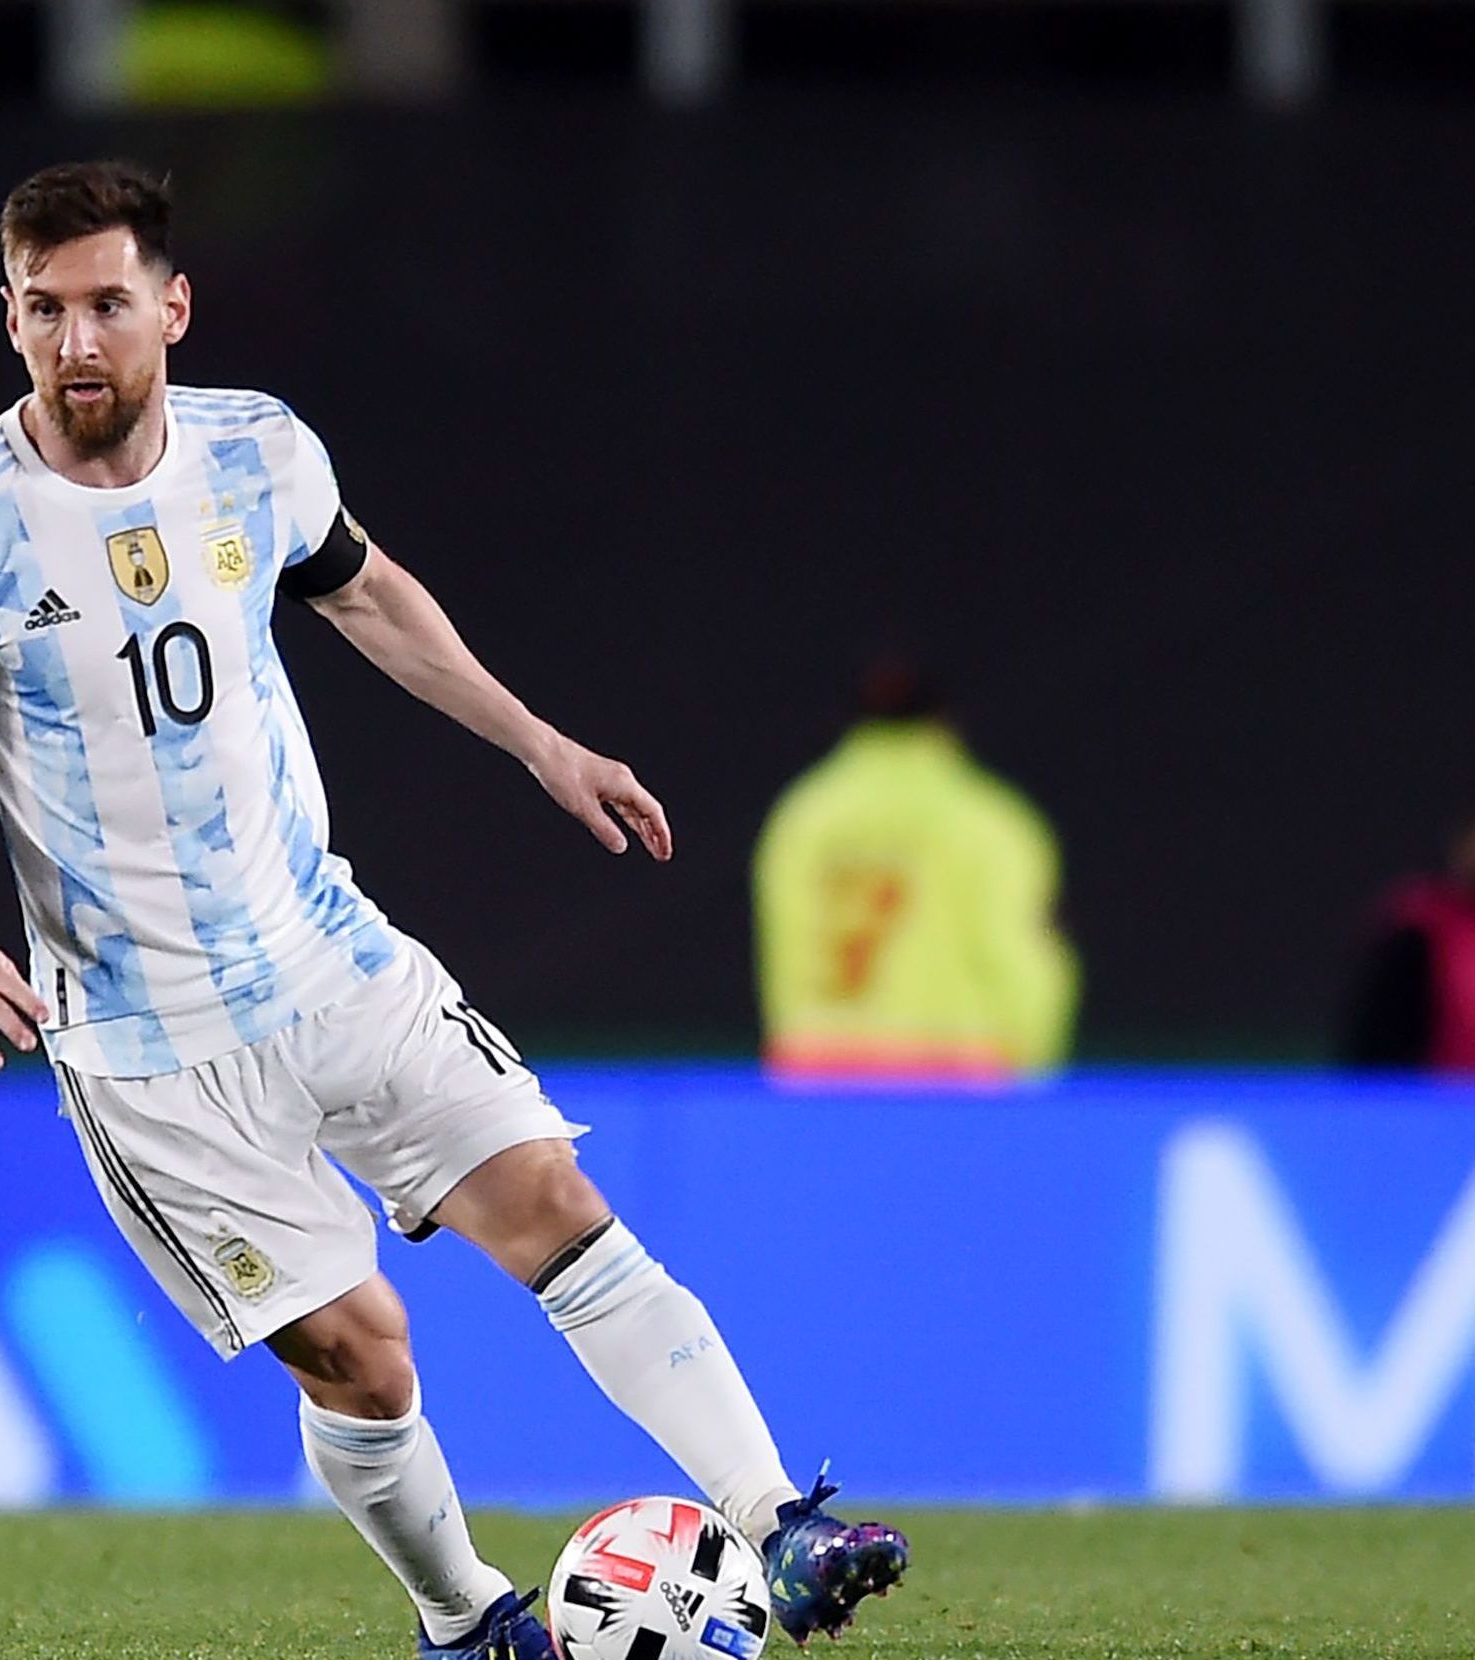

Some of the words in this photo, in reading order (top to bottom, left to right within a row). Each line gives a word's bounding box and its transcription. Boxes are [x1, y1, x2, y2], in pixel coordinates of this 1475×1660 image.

[24, 610, 82, 631] adidas
[117, 621, 215, 736] 10
[669, 1335, 715, 1369] AFA
[659, 1581, 691, 1633] adidas
